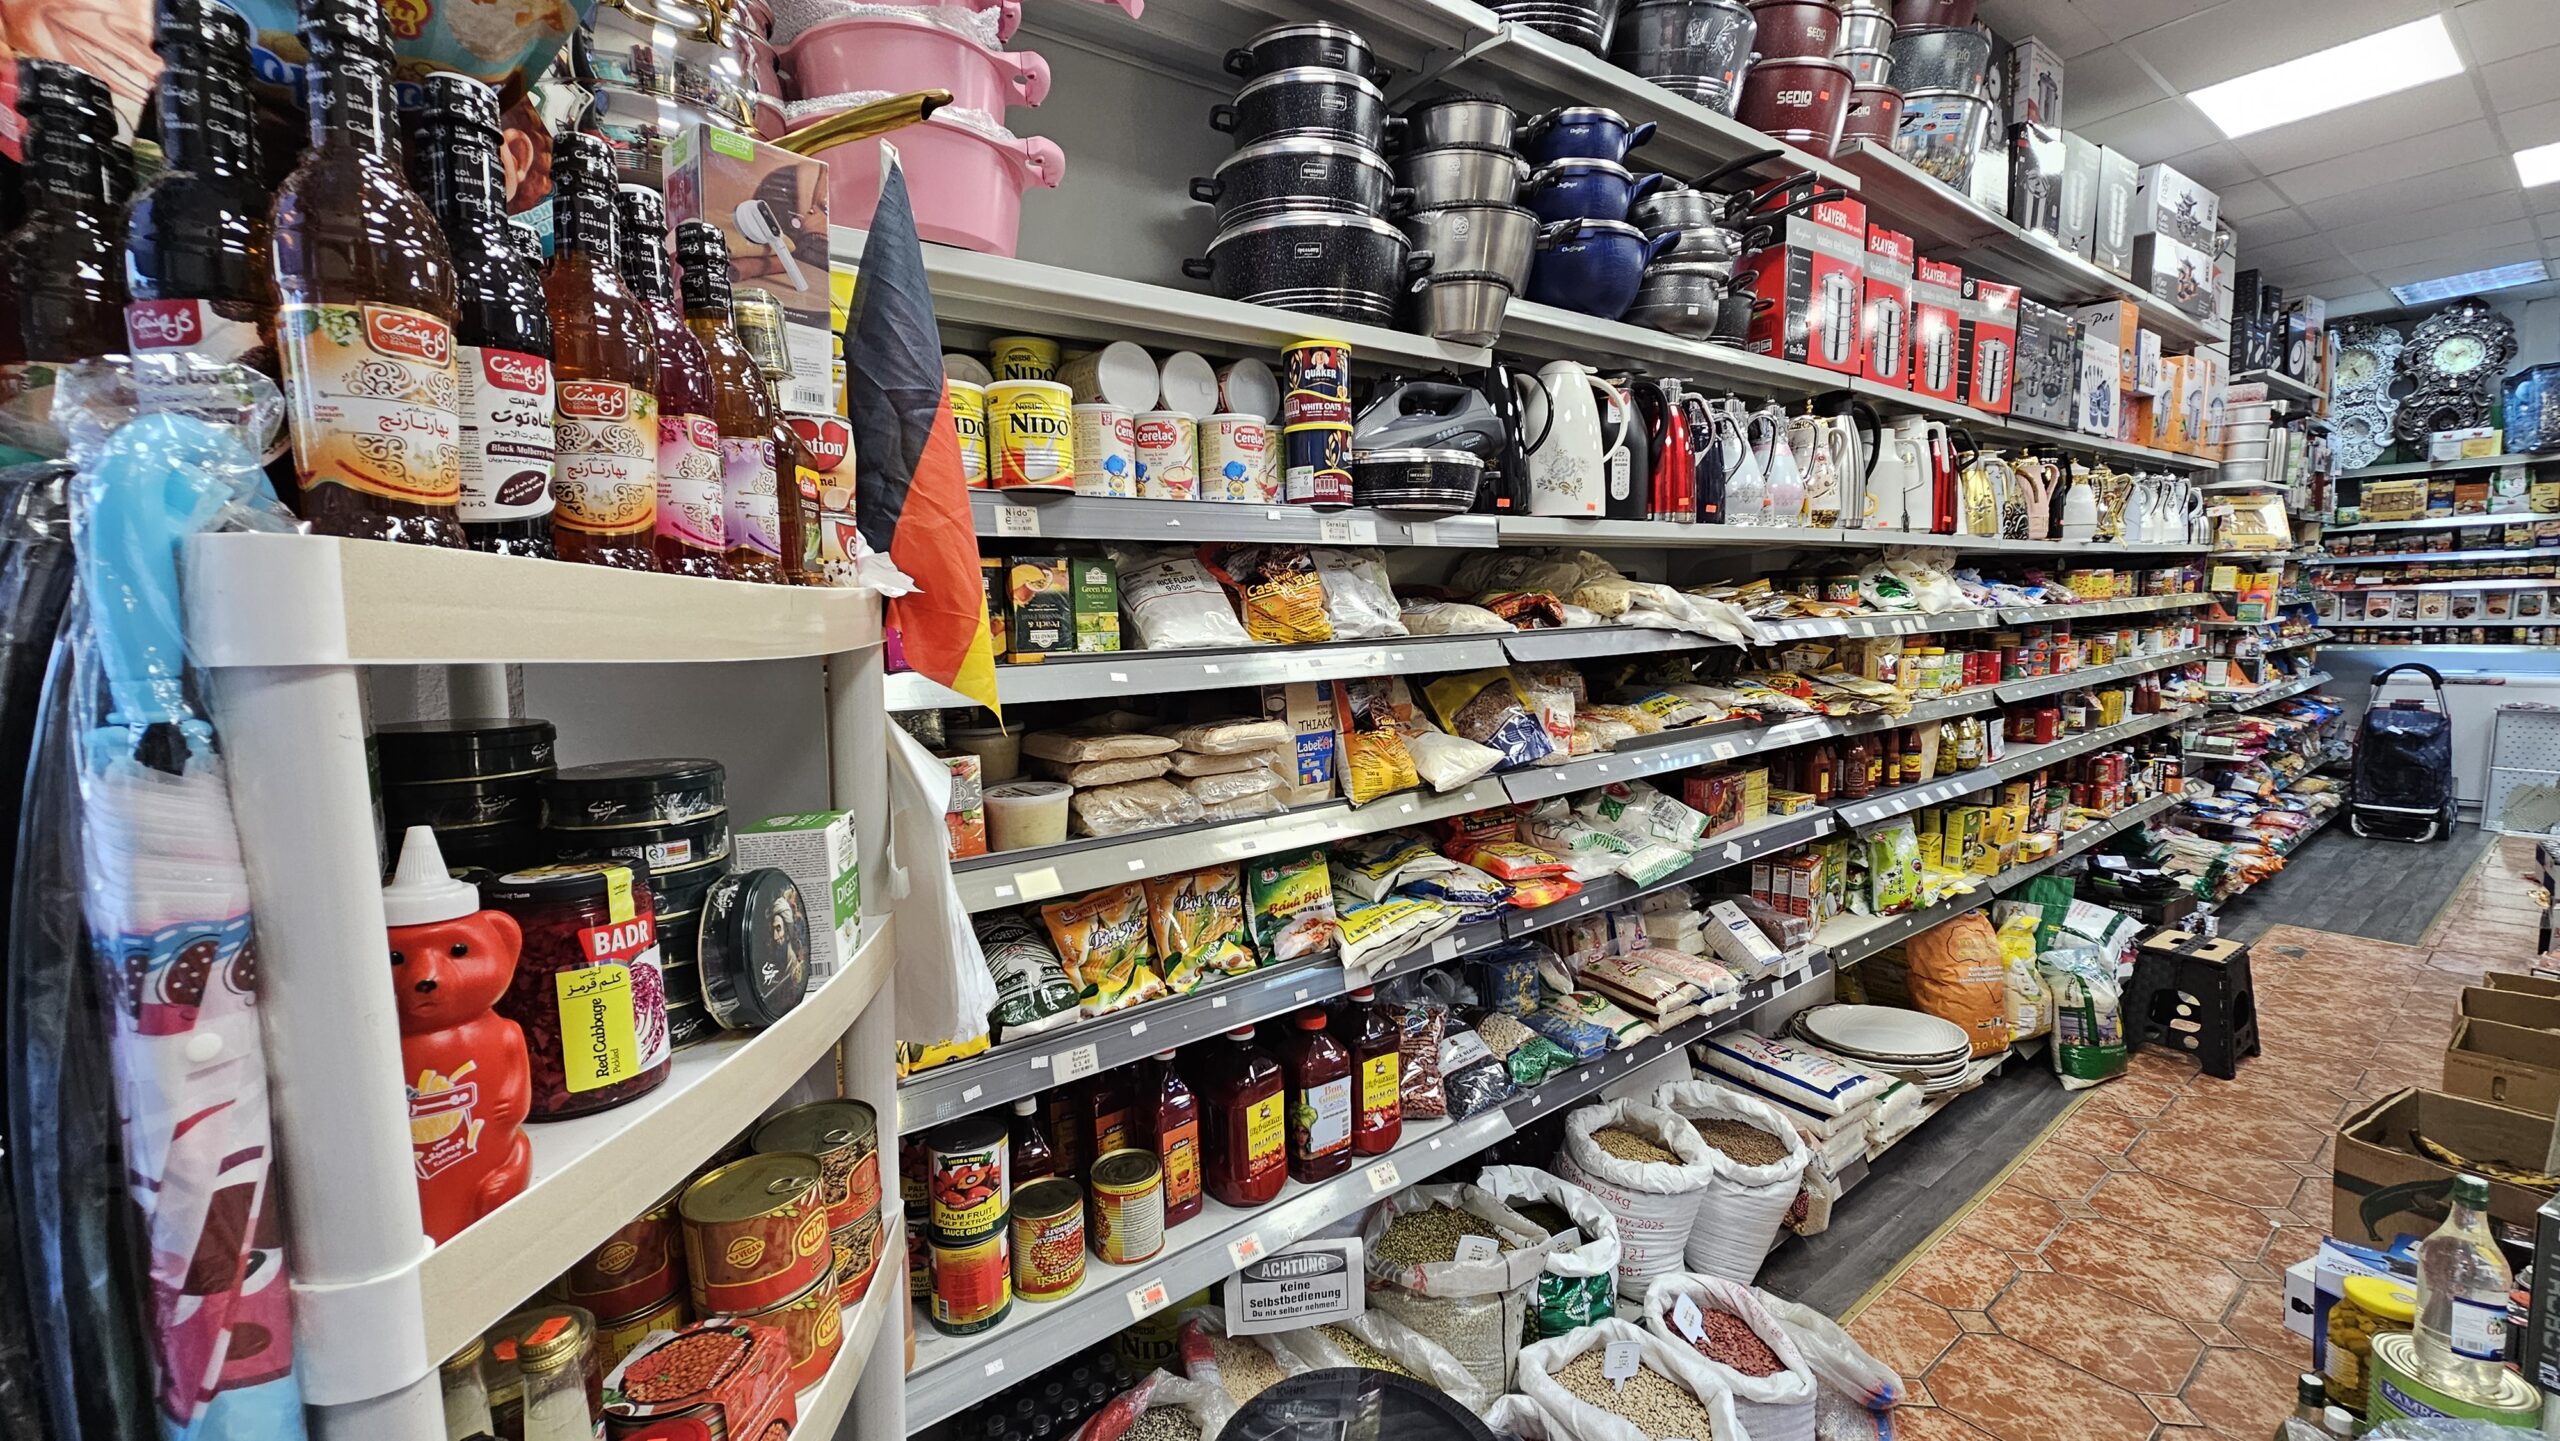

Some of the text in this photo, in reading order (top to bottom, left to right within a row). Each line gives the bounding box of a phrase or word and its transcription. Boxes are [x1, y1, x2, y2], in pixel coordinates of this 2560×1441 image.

[1776, 90, 1813, 108] SEDIQ
[580, 212, 595, 220] GOL
[1304, 368, 1337, 381] QUAKER
[313, 403, 340, 412] Orange
[1301, 402, 1324, 412] WHITE
[1324, 402, 1342, 411] OATS
[378, 413, 450, 440] بهارنارنج
[491, 411, 531, 429] توت
[1009, 413, 1069, 435] NIDO
[1137, 430, 1174, 442] Cerelac
[491, 443, 514, 455] Black
[566, 461, 628, 479] بهارنارنج
[1005, 507, 1028, 517] Nido
[1156, 574, 1197, 586] RICE FLOUR
[1100, 585, 1112, 593] Tea
[1466, 824, 1480, 832] The
[1174, 893, 1204, 913] Bột
[593, 919, 650, 957] BADR
[567, 971, 623, 997] کلم قرمز
[590, 997, 610, 1079] Red Cabbage
[612, 1048, 621, 1074] Pickled
[948, 1158, 963, 1166] FRESH
[1598, 1185, 1633, 1211] 25kg
[938, 1212, 998, 1227] PULP EXTRACT
[940, 1206, 993, 1221] PALM FRUIT
[942, 1223, 994, 1237] SAUCE GRAINE
[1637, 1219, 1665, 1231] 2025
[608, 1245, 637, 1266] VEGAN
[738, 1241, 764, 1258] VEGAN
[1261, 1256, 1328, 1278] ACHTUNG
[1280, 1281, 1311, 1294] Keine
[1249, 1288, 1342, 1309] Selbstbedienung
[1252, 1300, 1339, 1318] Du nix selber nehmen!
